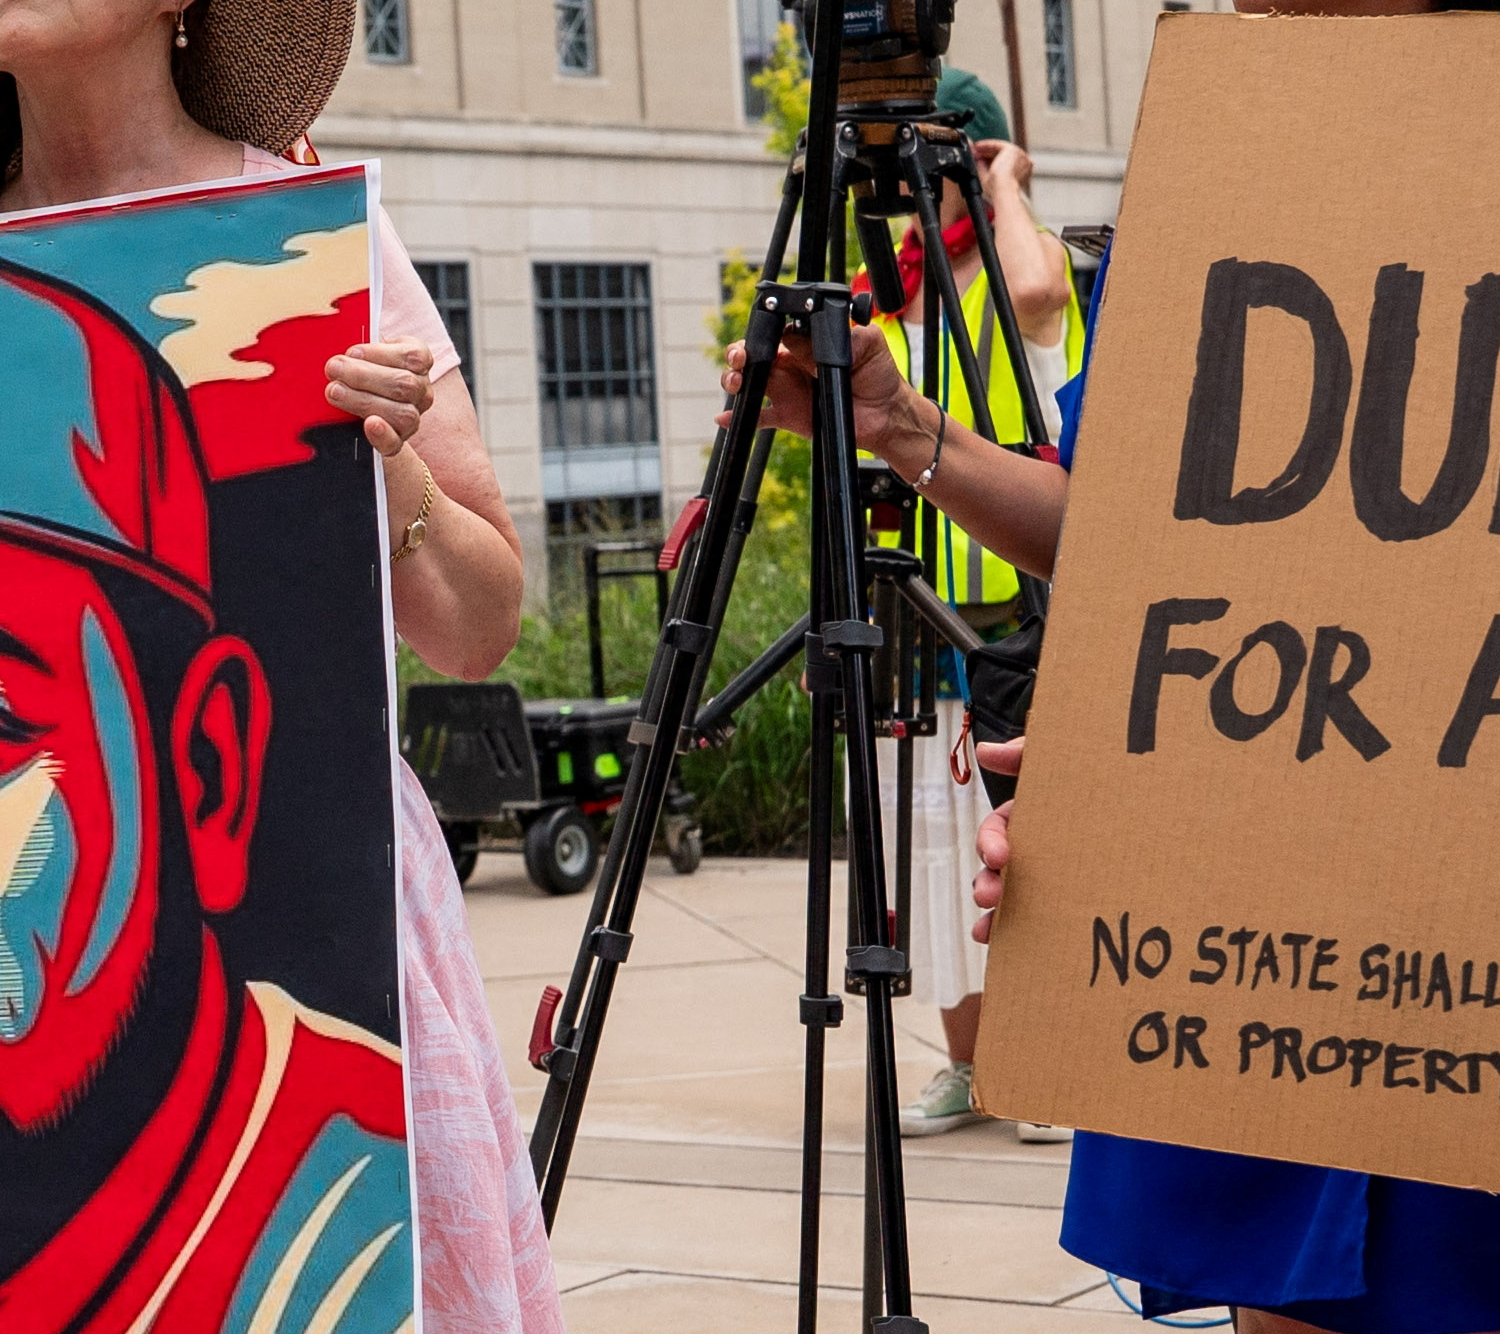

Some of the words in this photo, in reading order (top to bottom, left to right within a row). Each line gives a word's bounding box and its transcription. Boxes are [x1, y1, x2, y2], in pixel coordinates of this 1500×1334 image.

[1127, 597, 1392, 764] FOR
[1089, 911, 1173, 988] NO
[1189, 923, 1339, 992] STATE
[1126, 1011, 1212, 1070] OR
